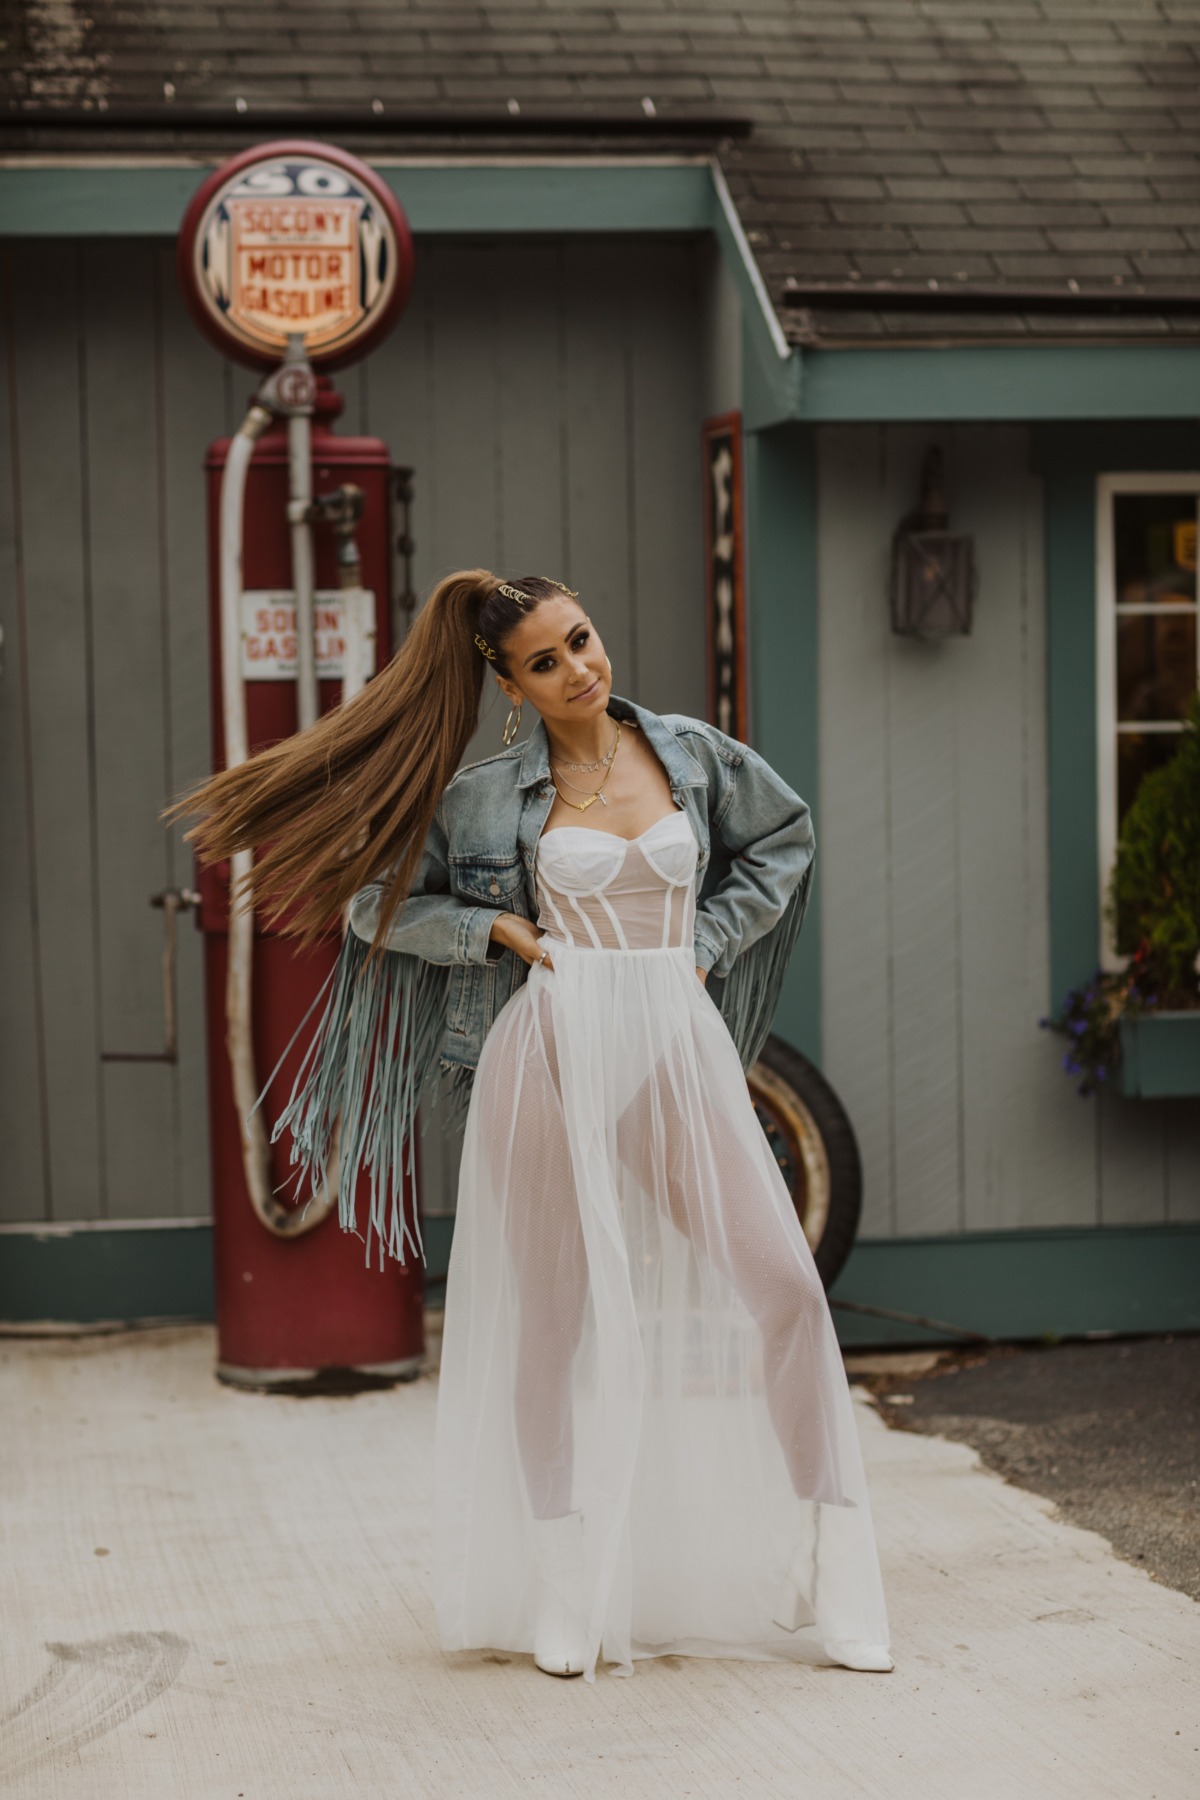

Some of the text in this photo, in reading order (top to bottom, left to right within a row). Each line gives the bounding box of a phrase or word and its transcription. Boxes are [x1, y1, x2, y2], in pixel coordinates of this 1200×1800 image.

[243, 210, 344, 235] SOCONY
[249, 254, 343, 281] MOTOR
[242, 286, 349, 320] GASOLINE
